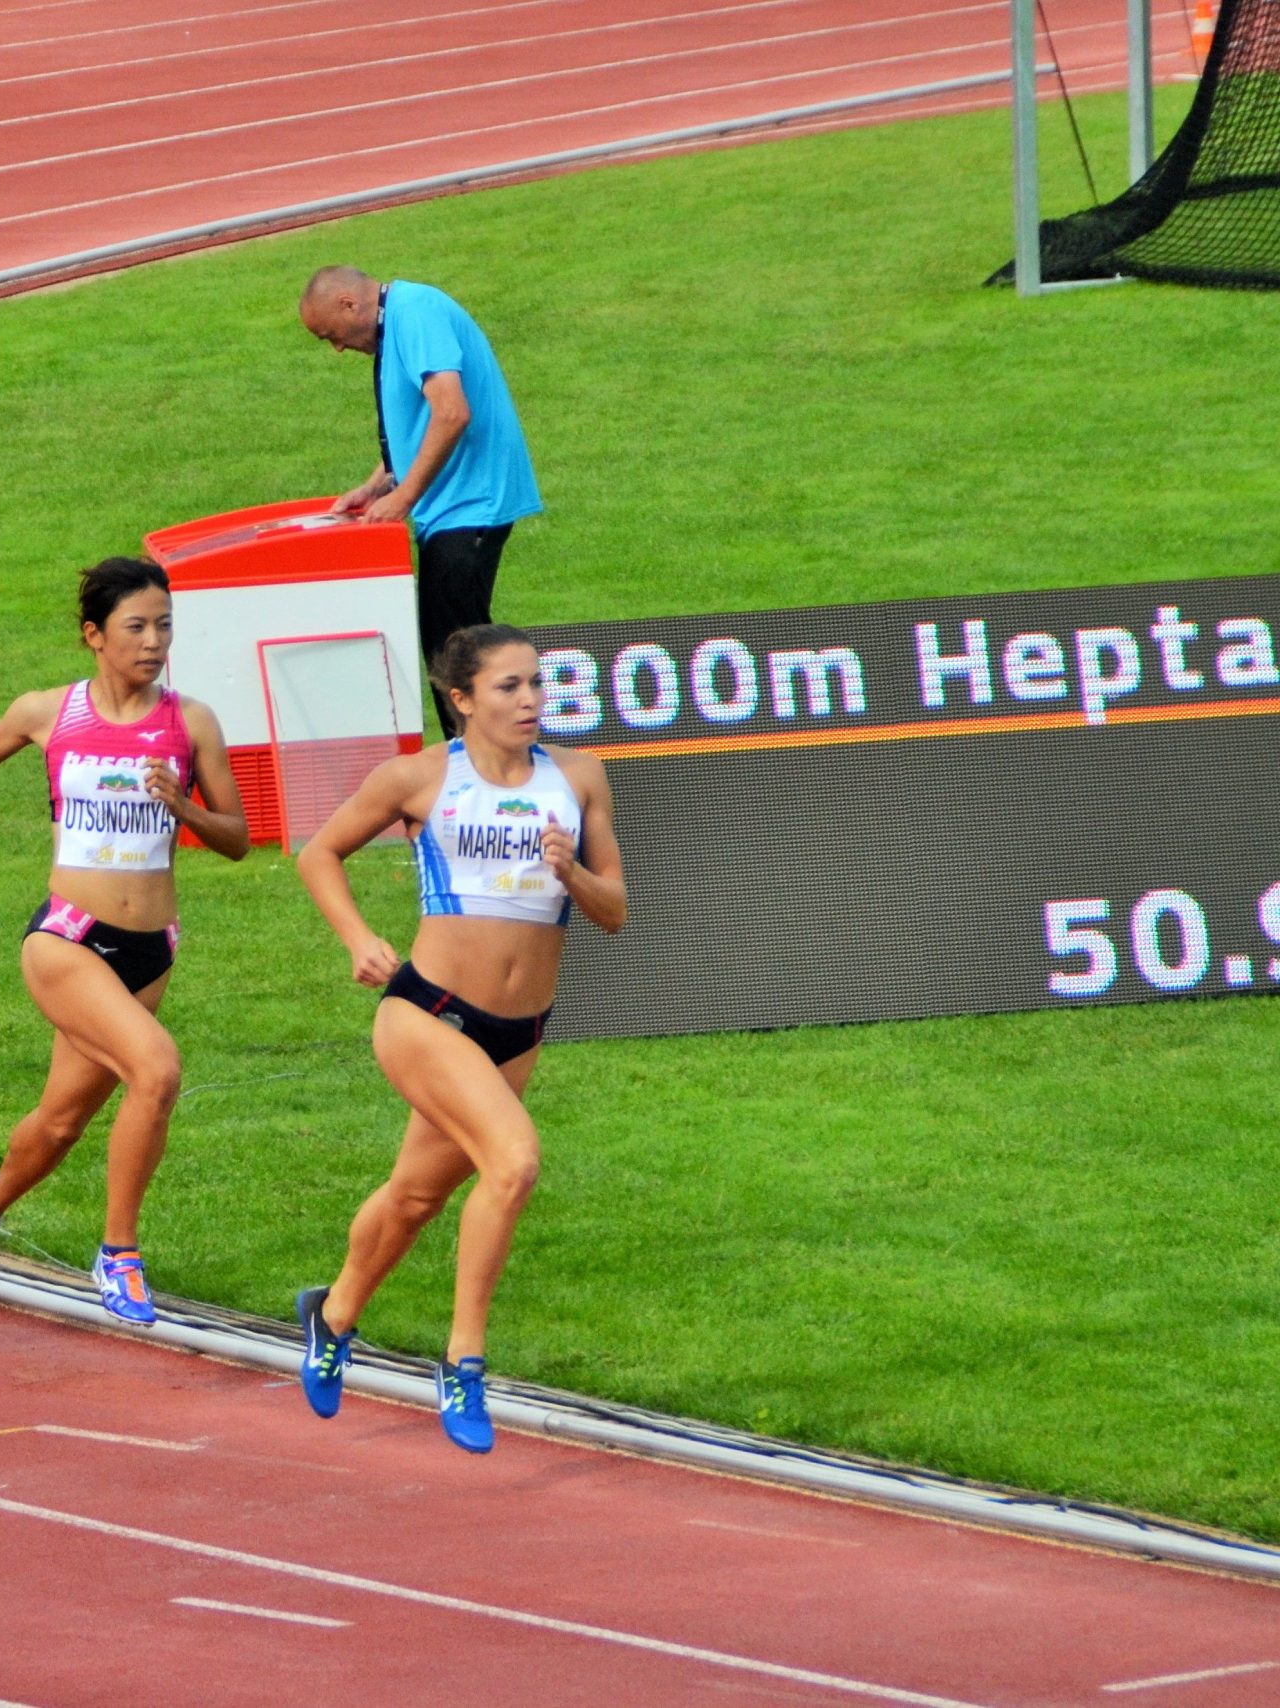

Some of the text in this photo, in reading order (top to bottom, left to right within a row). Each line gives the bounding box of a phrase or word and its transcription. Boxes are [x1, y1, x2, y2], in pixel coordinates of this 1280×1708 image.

[537, 603, 1280, 736] 800m Hepta
[64, 796, 173, 835] UTSUNOMIYA
[457, 823, 577, 862] MARIE-HA
